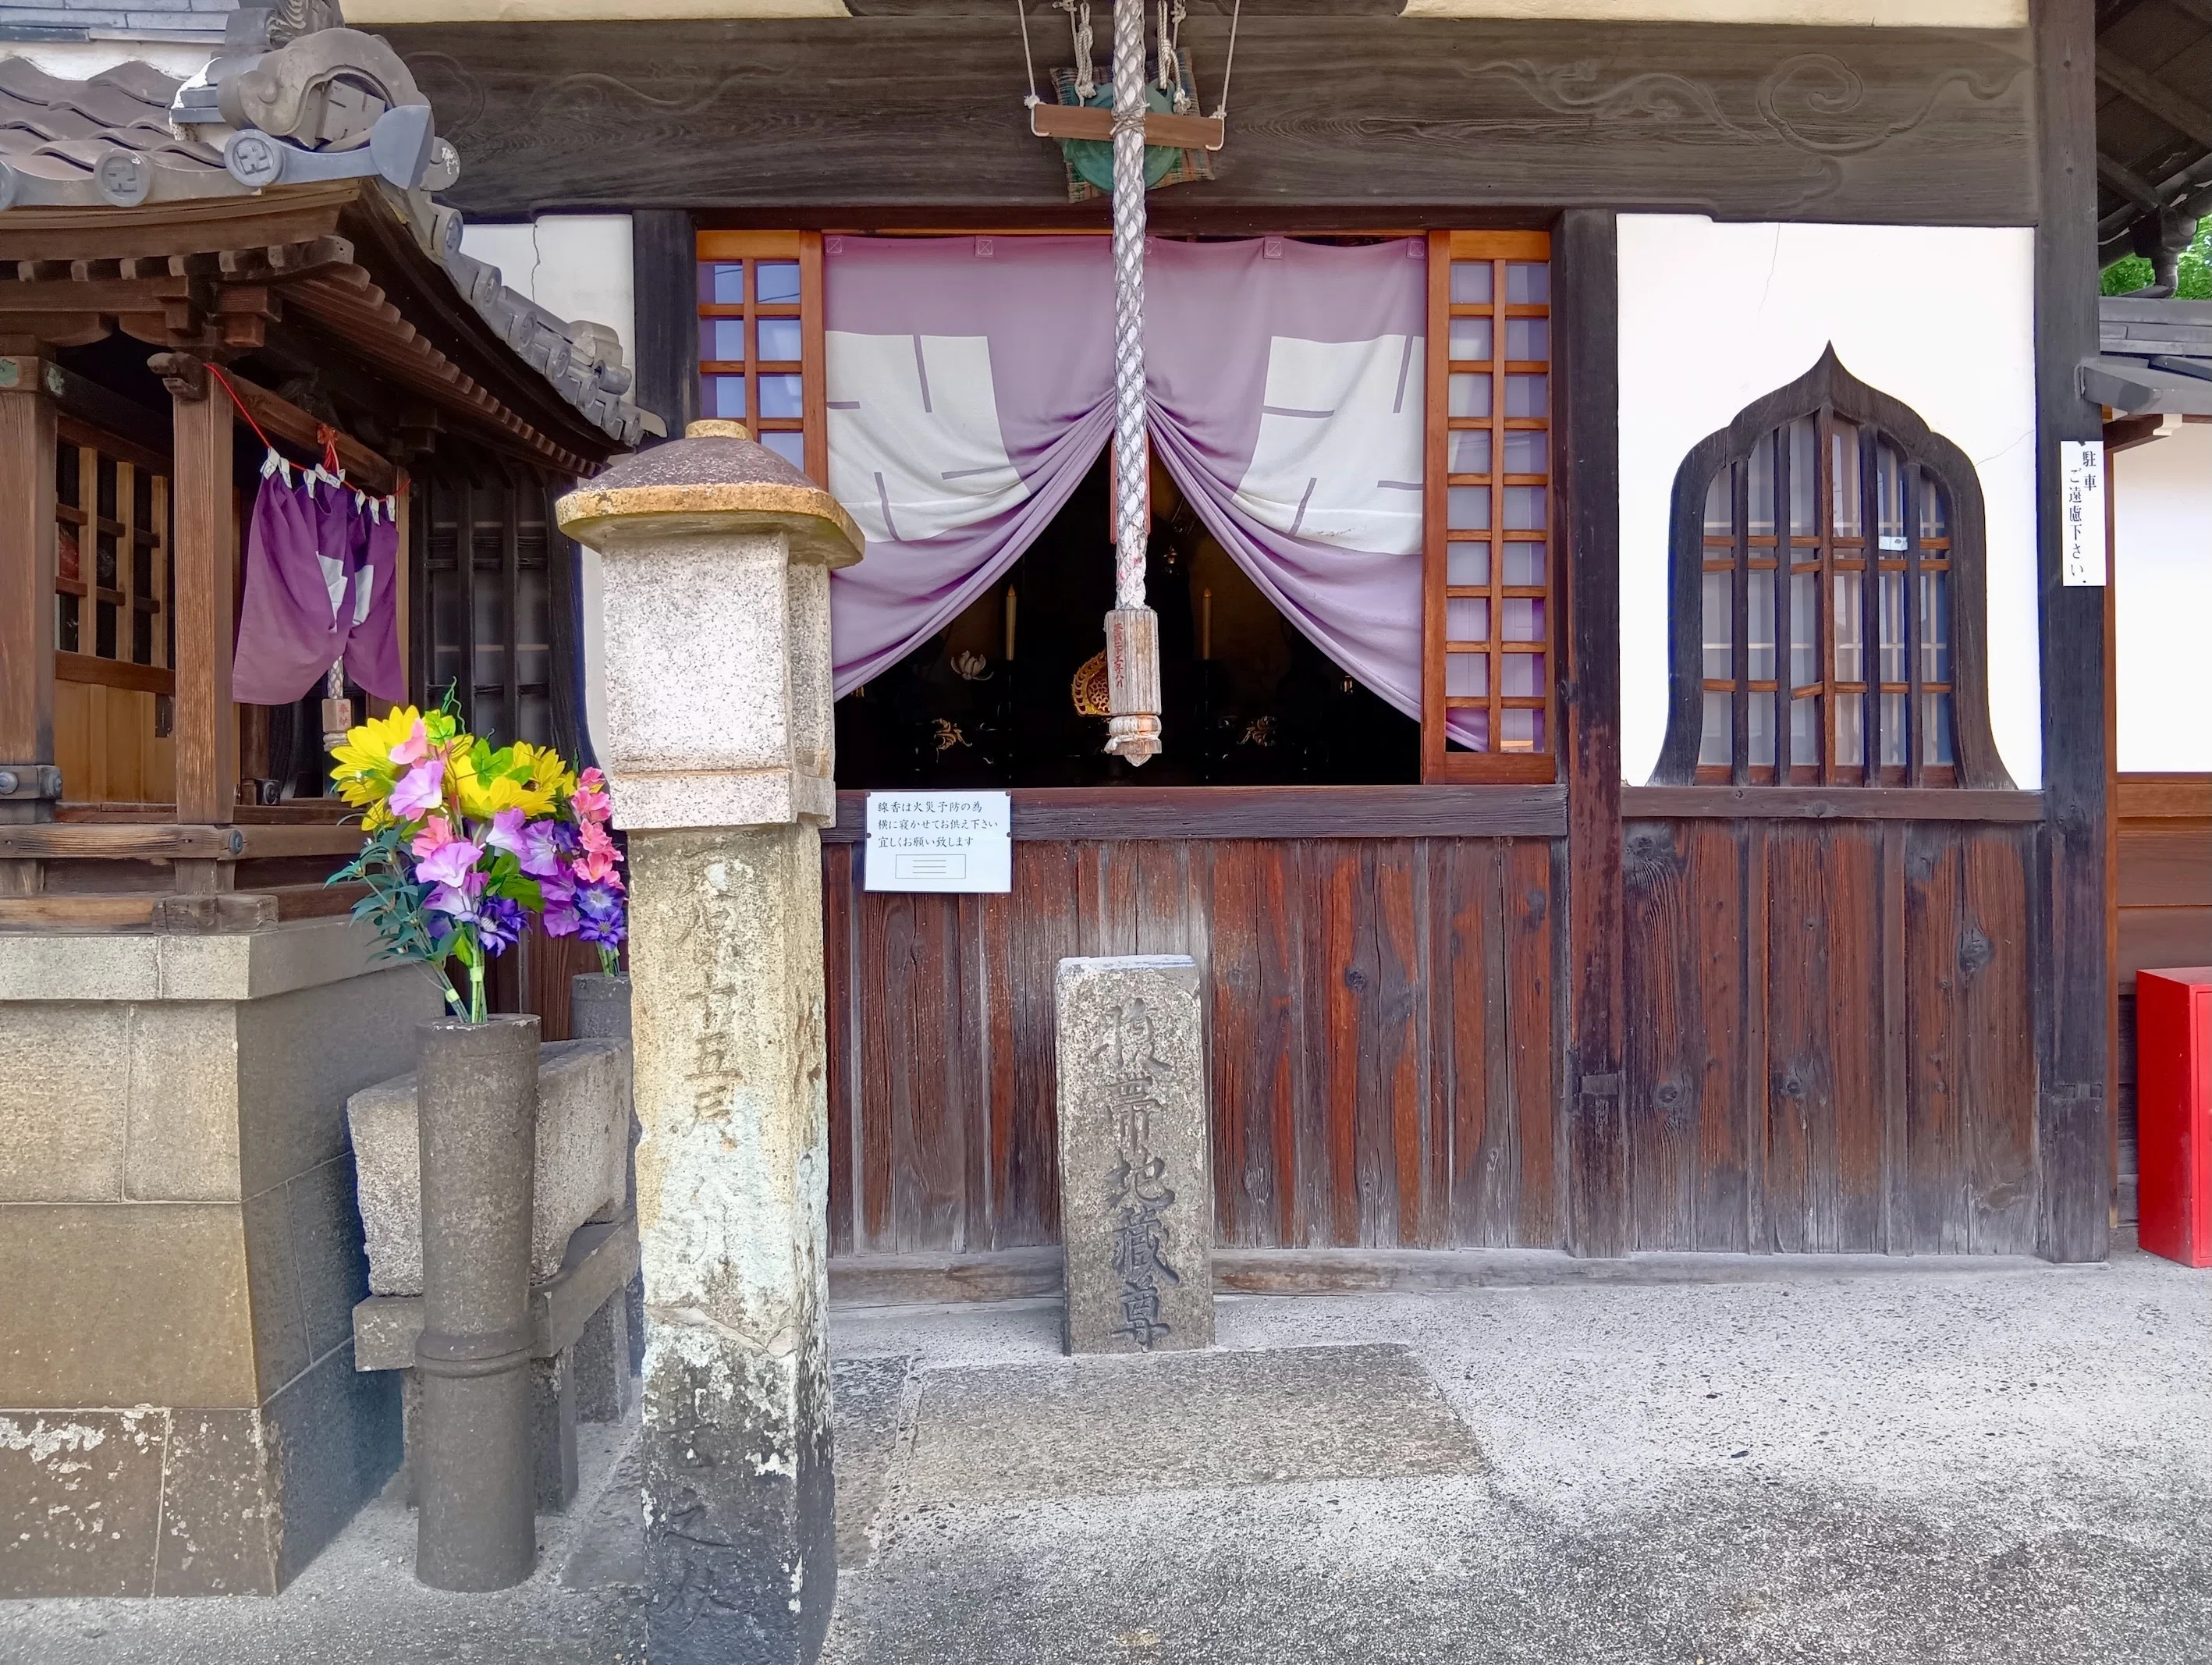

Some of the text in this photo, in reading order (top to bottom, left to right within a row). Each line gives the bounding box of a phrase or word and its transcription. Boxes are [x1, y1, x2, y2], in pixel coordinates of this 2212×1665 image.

[2082, 450, 2097, 492] 駐車
[2068, 468, 2084, 577] ご遠慮下さい
[877, 801, 983, 814] 線香は火災予防の為
[877, 818, 999, 831] 横に寝かせてお供え下さい
[877, 836, 975, 848] 宜しくお願い致します
